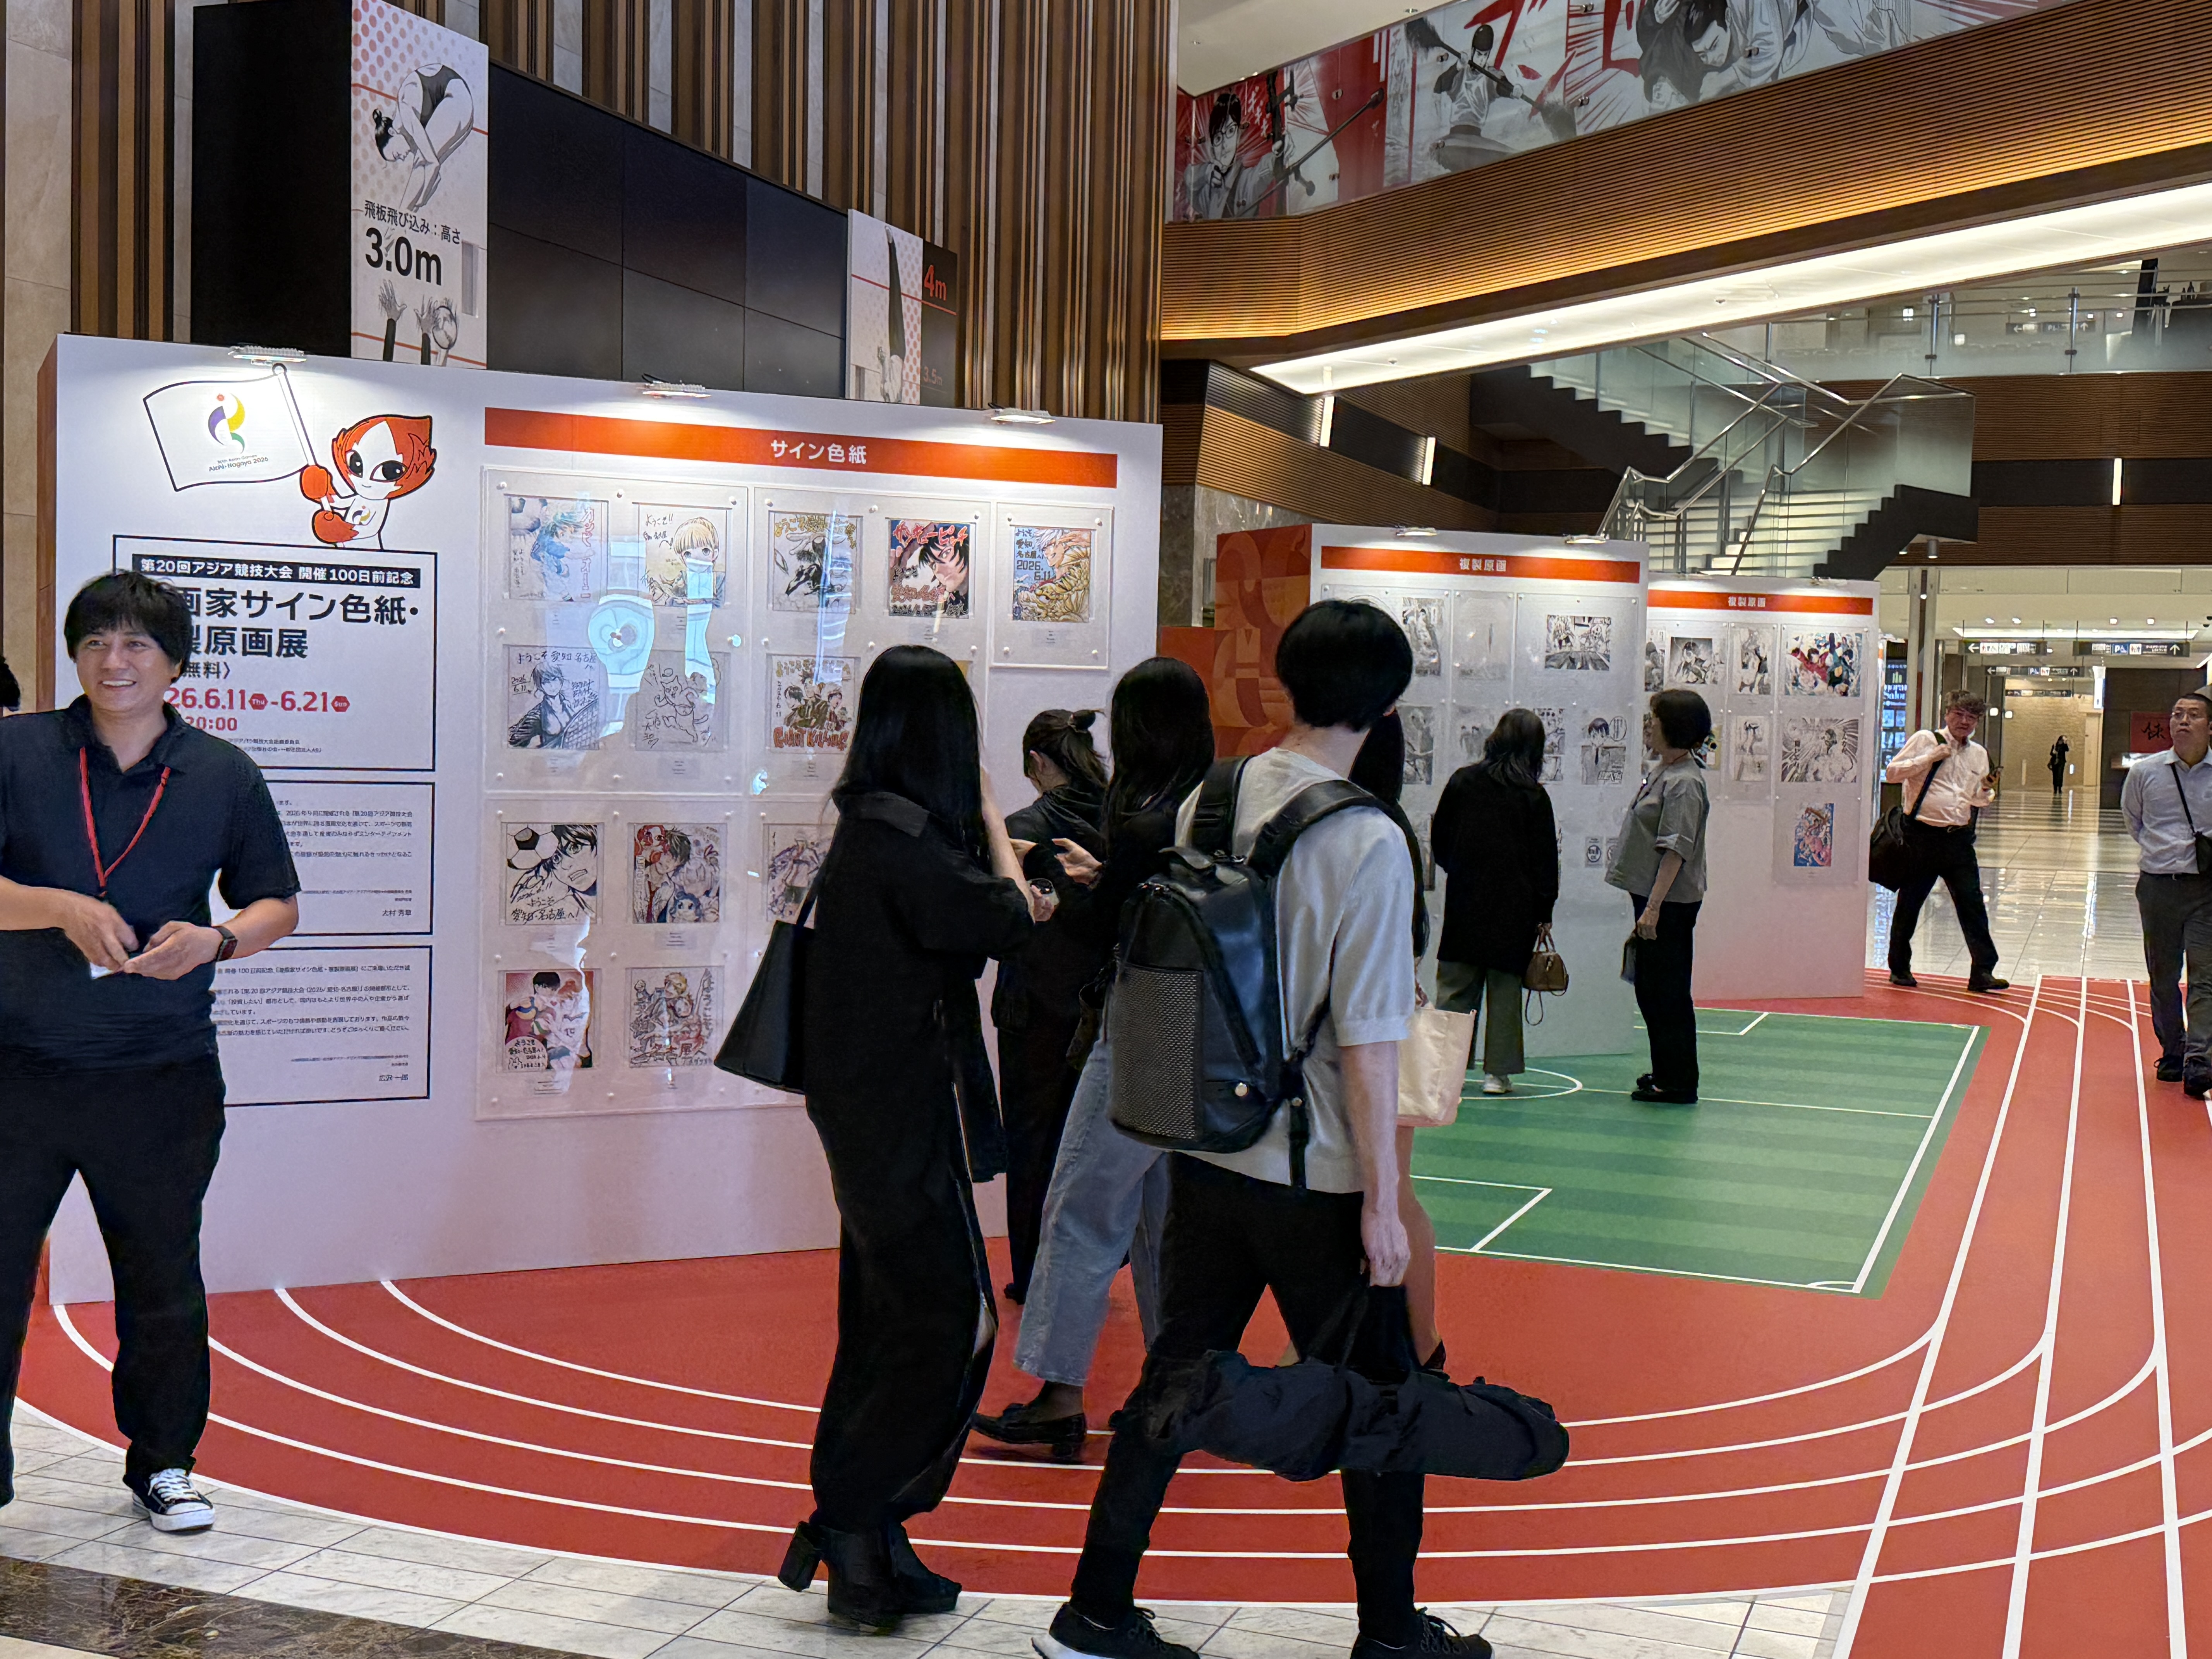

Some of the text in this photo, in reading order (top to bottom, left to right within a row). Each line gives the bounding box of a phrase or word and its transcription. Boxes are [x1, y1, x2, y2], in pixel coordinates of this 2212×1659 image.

[365, 200, 460, 244] 飛板飛び込み：高さ
[366, 227, 441, 286] 3.0m
[924, 265, 946, 301] 4m
[771, 440, 867, 464] サイン色紙
[141, 558, 293, 579] 第20回アジア競技大会
[1460, 558, 1506, 572] 複製原画
